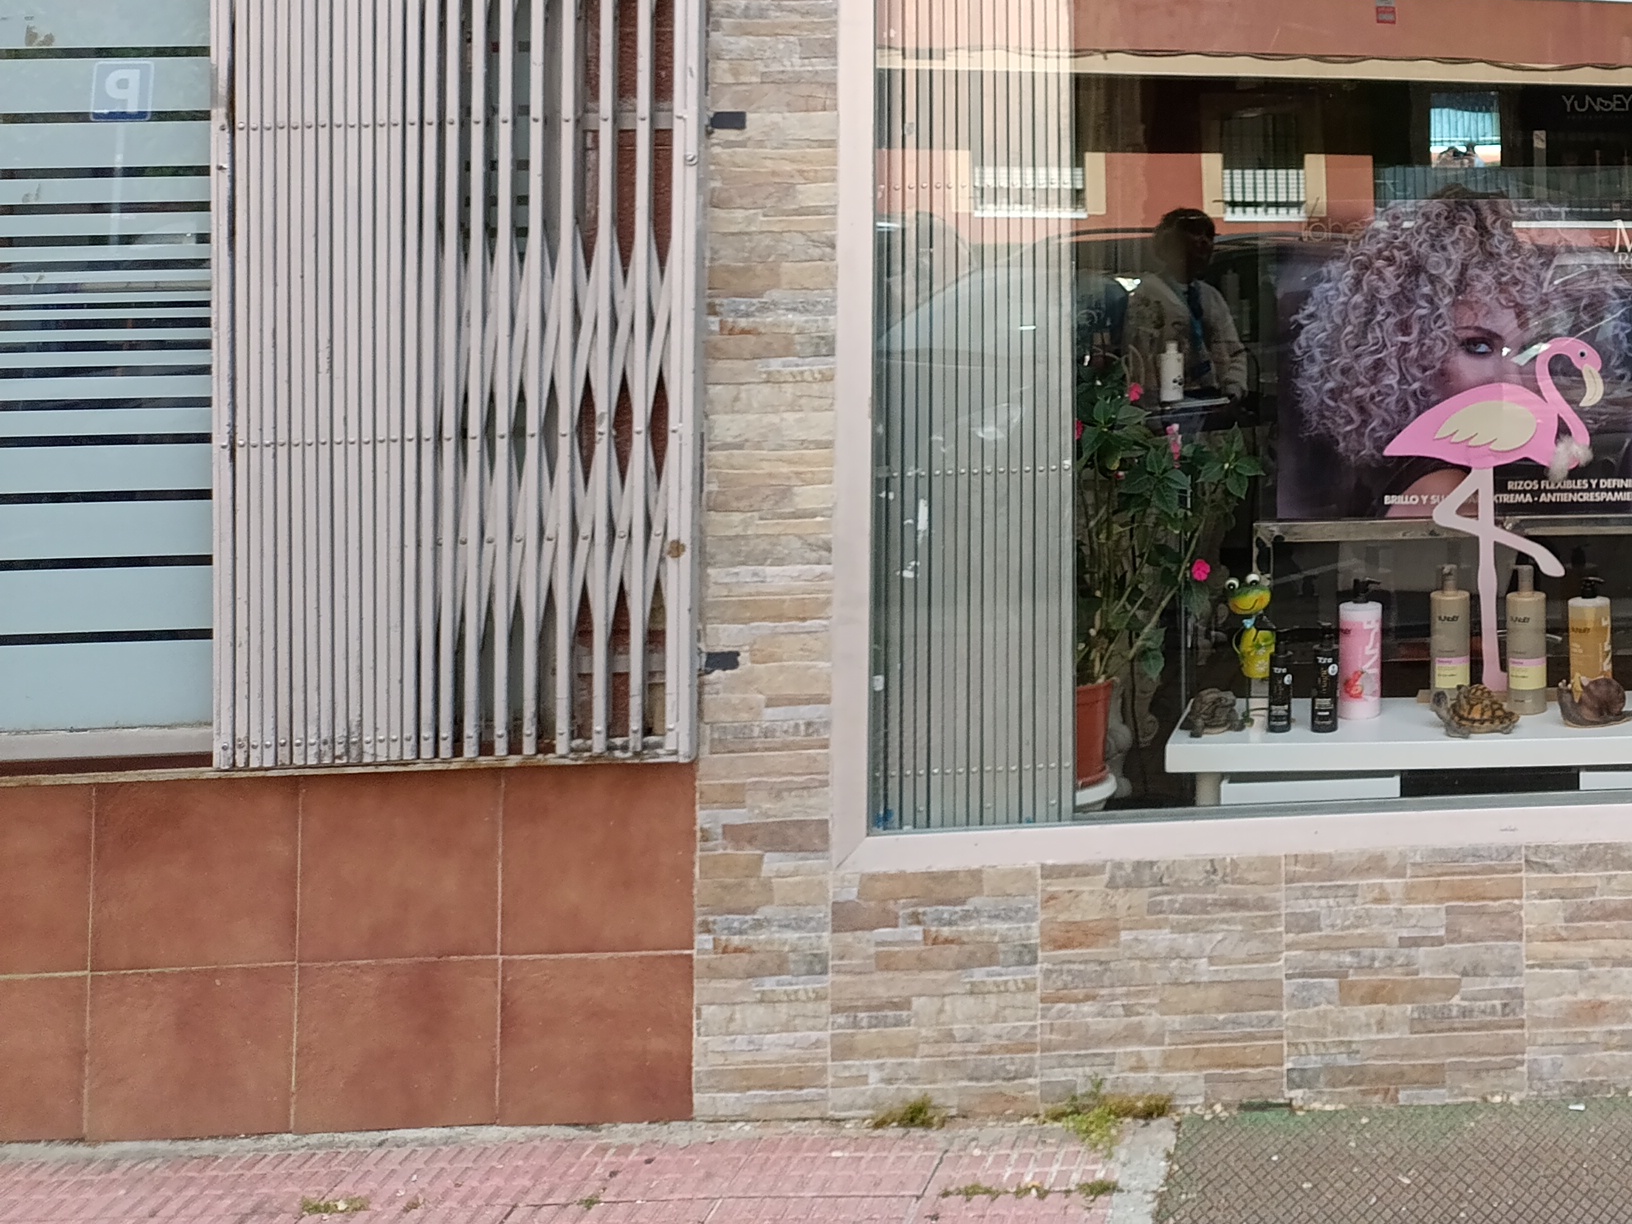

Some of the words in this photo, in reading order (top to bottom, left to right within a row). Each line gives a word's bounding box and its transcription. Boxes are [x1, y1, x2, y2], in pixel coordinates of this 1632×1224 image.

[1507, 479, 1539, 491] RIZOS
[1589, 478, 1598, 489] Y
[1383, 494, 1419, 505] BRILLO
[1418, 494, 1428, 505] Y
[1493, 493, 1533, 504] XTREMA
